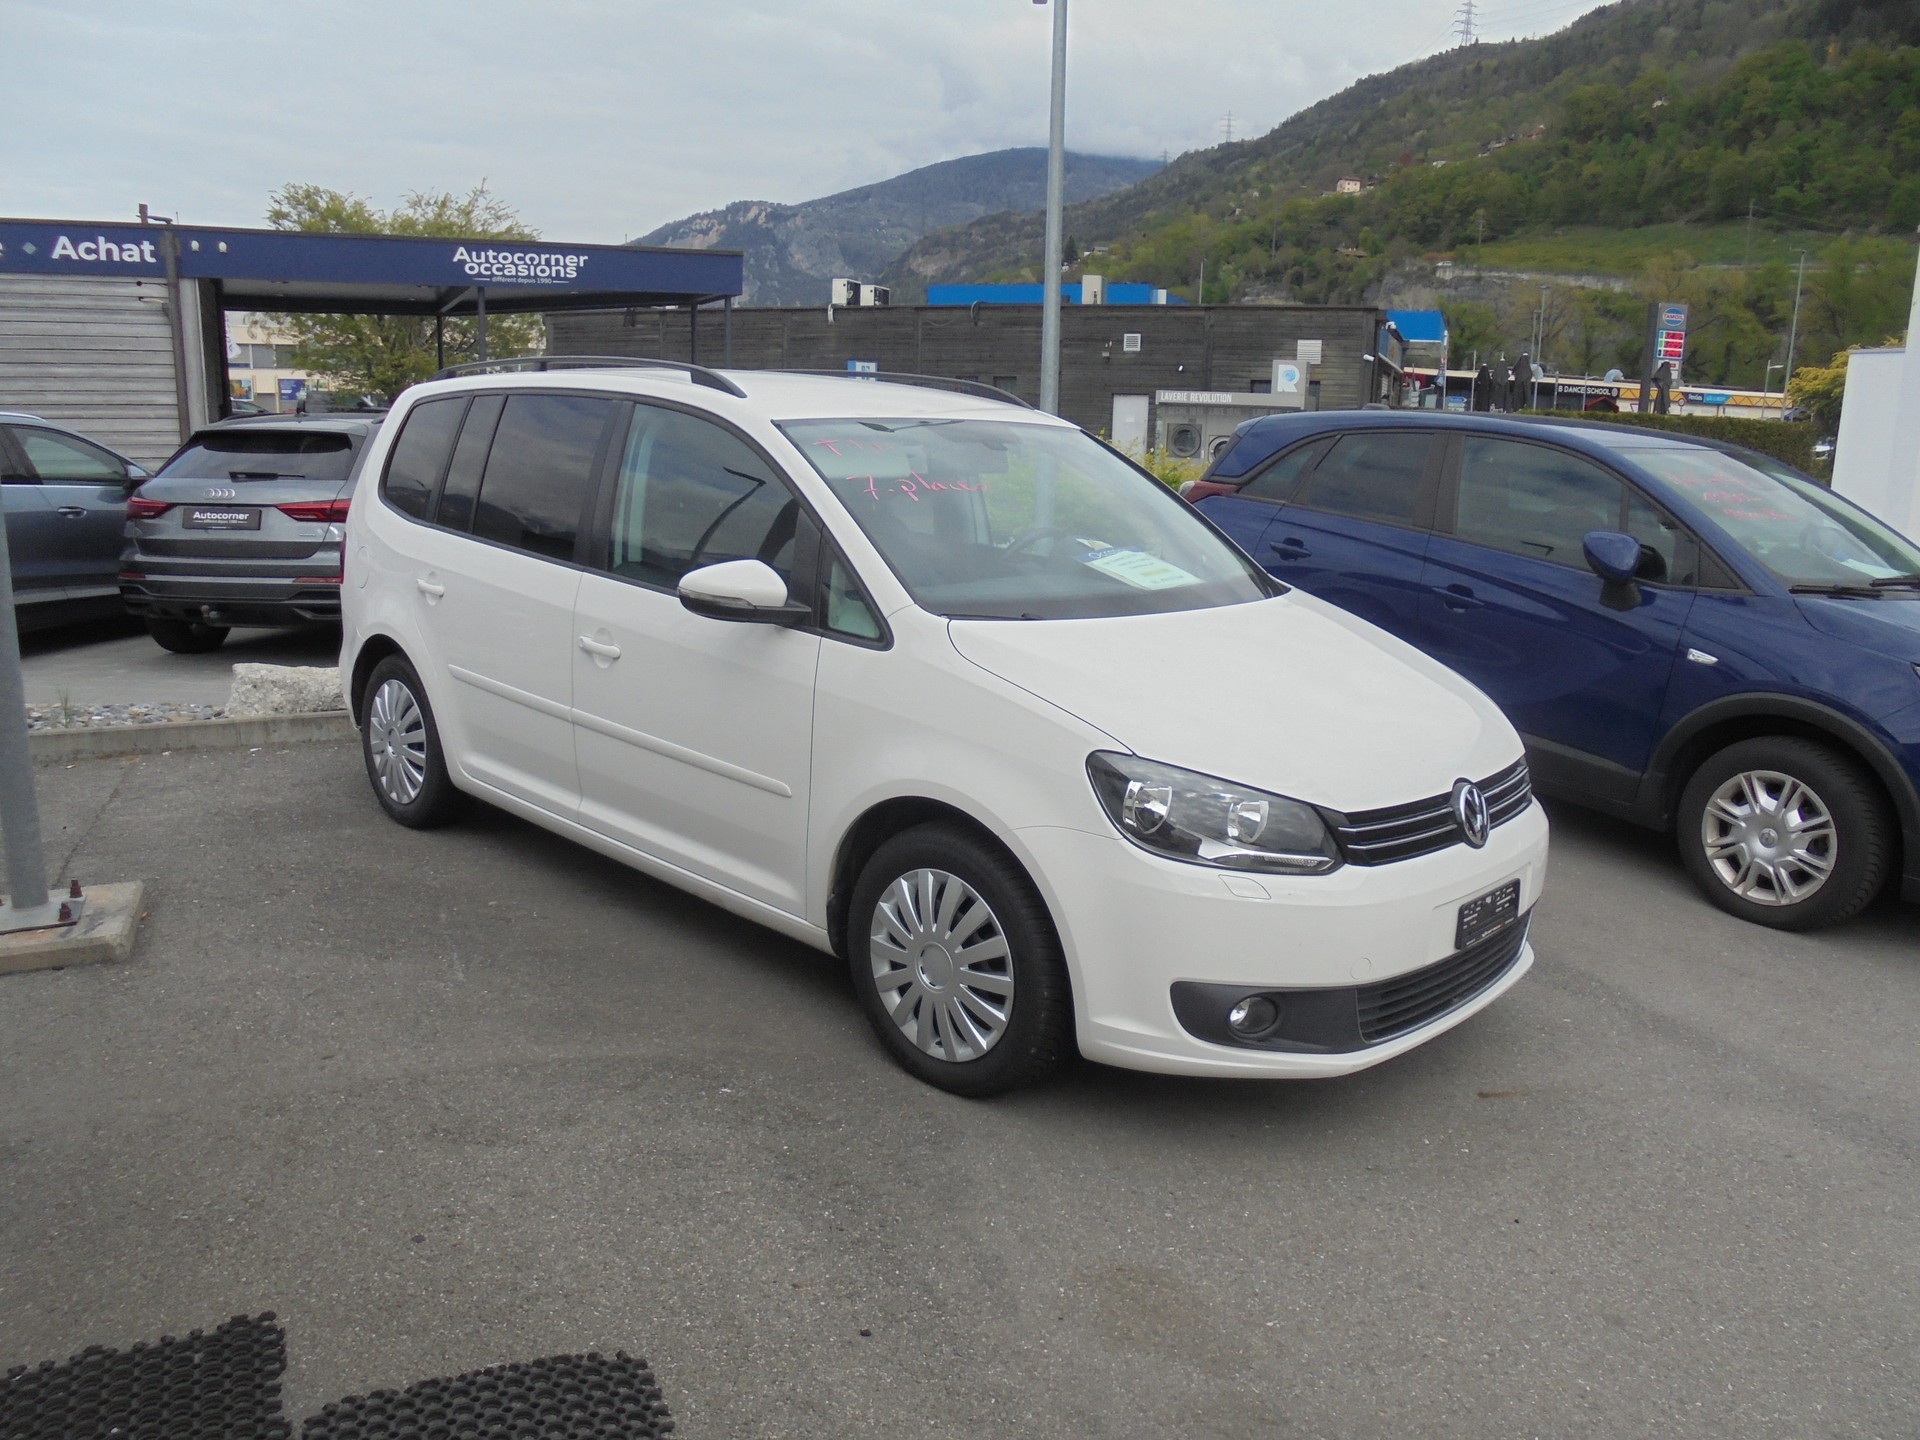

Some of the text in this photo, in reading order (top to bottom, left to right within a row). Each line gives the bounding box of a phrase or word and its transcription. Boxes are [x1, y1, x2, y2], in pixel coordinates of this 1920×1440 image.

[51, 235, 157, 263] Achat
[452, 246, 589, 267] Autocorner
[464, 263, 578, 278] occasions
[1160, 391, 1232, 403] LAVERIE REVOLUTION
[1564, 386, 1585, 394] DANCE
[1586, 387, 1611, 395] SCHOOL
[193, 511, 250, 520] Autocorner
